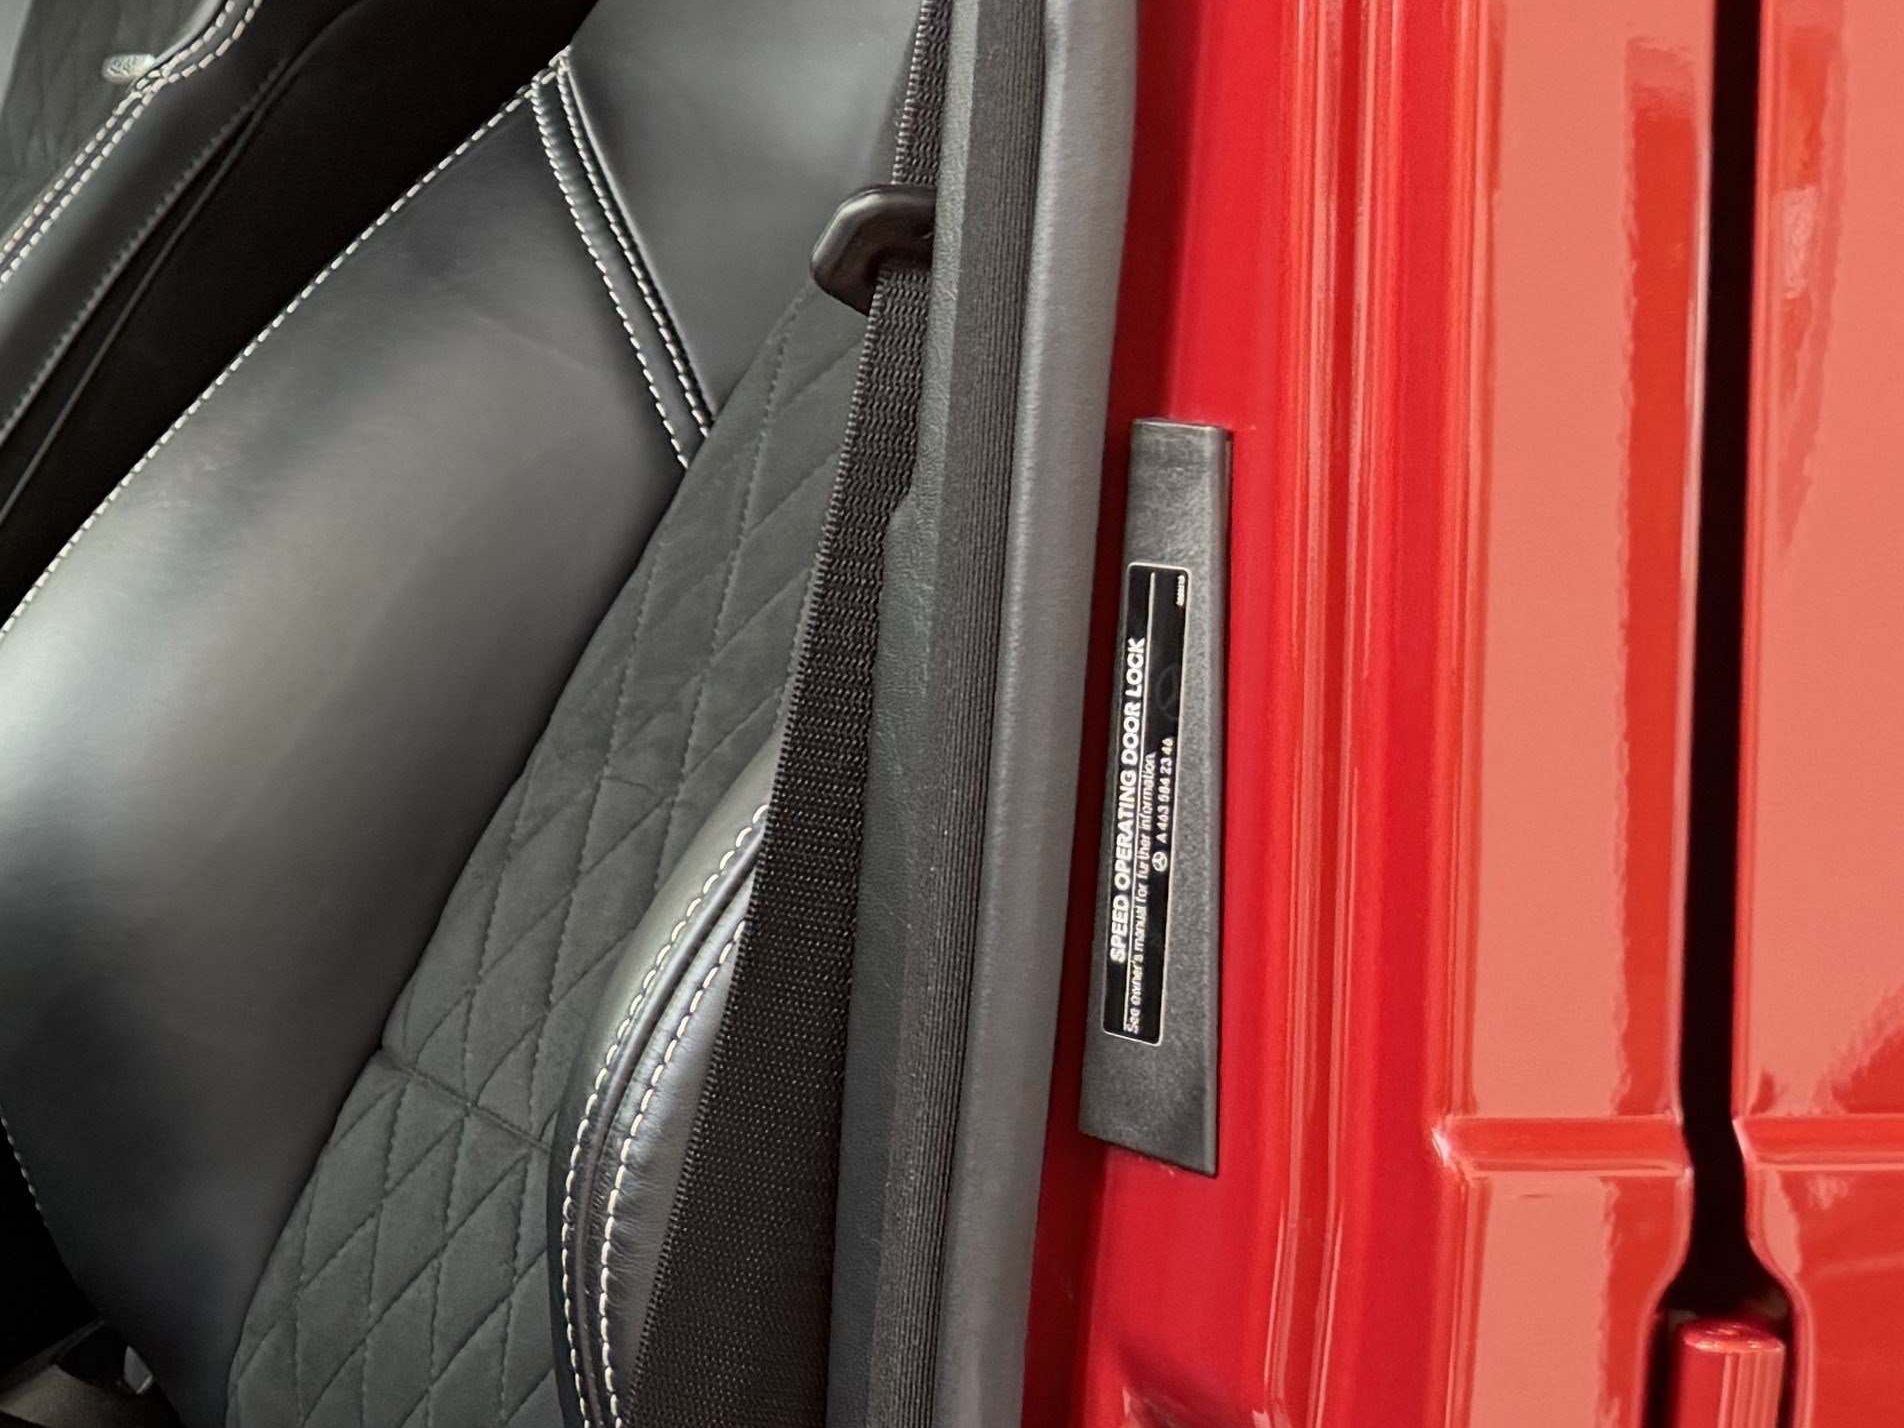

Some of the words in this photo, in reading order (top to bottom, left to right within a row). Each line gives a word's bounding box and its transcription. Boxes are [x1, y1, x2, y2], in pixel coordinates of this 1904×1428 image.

[1125, 638, 1145, 698] LOCK
[1121, 701, 1141, 765] DOOR
[1114, 769, 1136, 890] OPERATING
[1135, 832, 1151, 879] further
[1133, 881, 1148, 903] for
[1110, 894, 1129, 963] SPEED
[1134, 905, 1147, 952] manual
[1126, 1007, 1140, 1034] See
